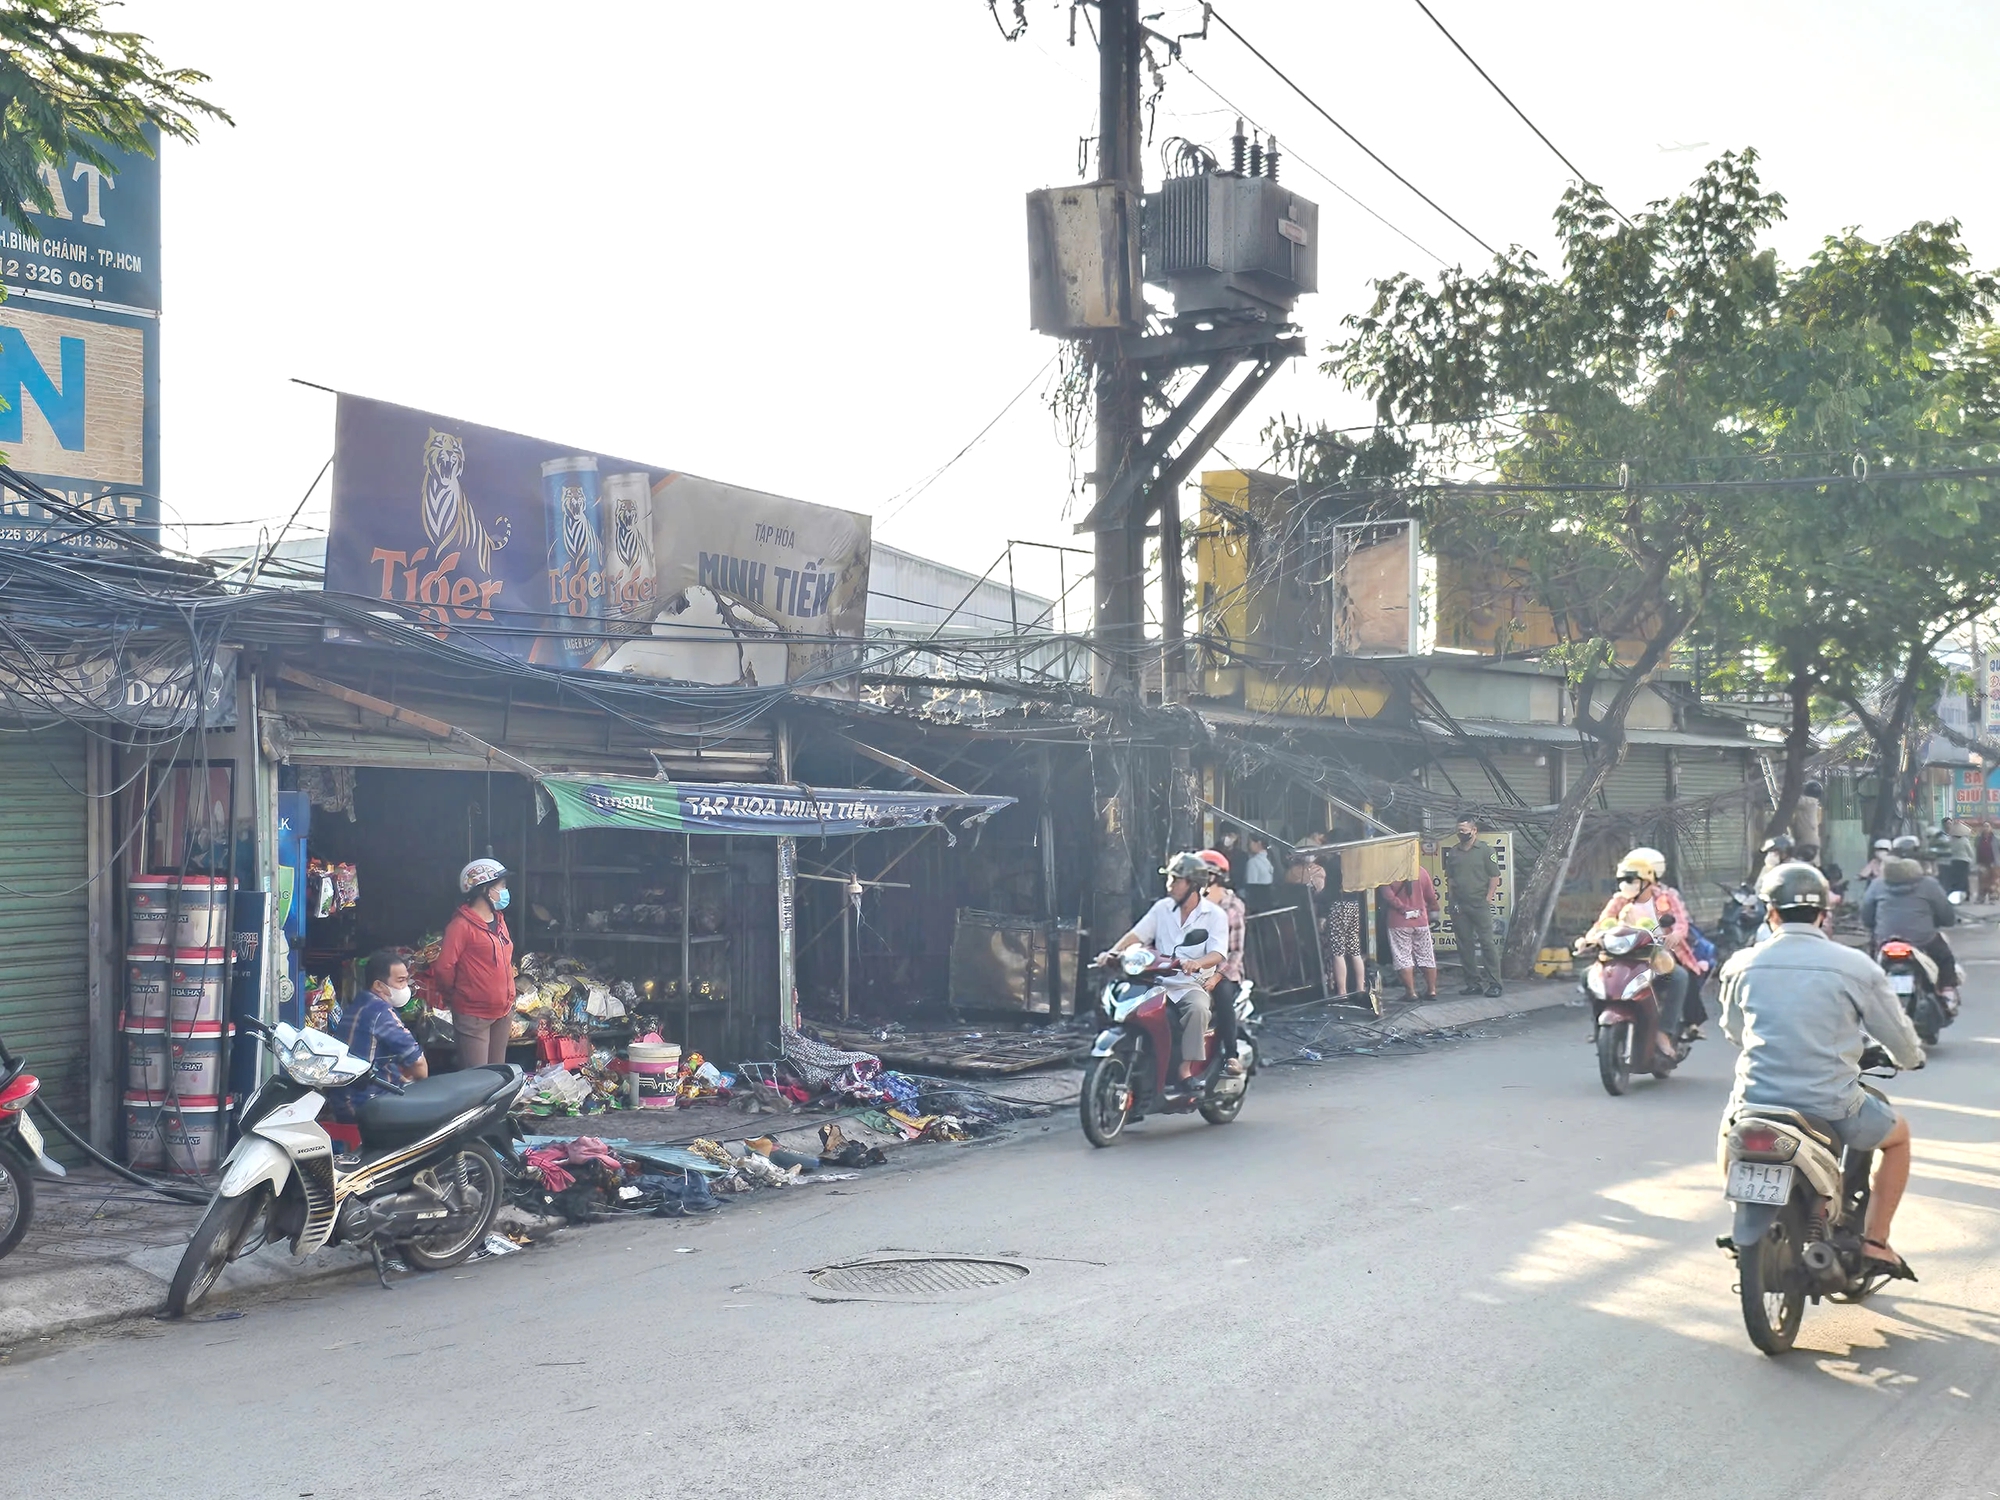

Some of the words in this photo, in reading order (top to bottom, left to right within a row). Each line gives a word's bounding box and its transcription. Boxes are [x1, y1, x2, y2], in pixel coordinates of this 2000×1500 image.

[43, 237, 87, 262] CHÁNH
[98, 248, 142, 273] TP.HCM
[25, 263, 63, 285] 326
[69, 271, 104, 292] 061
[775, 525, 795, 549] HÓA
[371, 547, 503, 641] Tiger
[549, 557, 607, 618] Tiger
[698, 551, 767, 605] MINH
[774, 558, 836, 618] TIẾN
[781, 799, 832, 819] MINH
